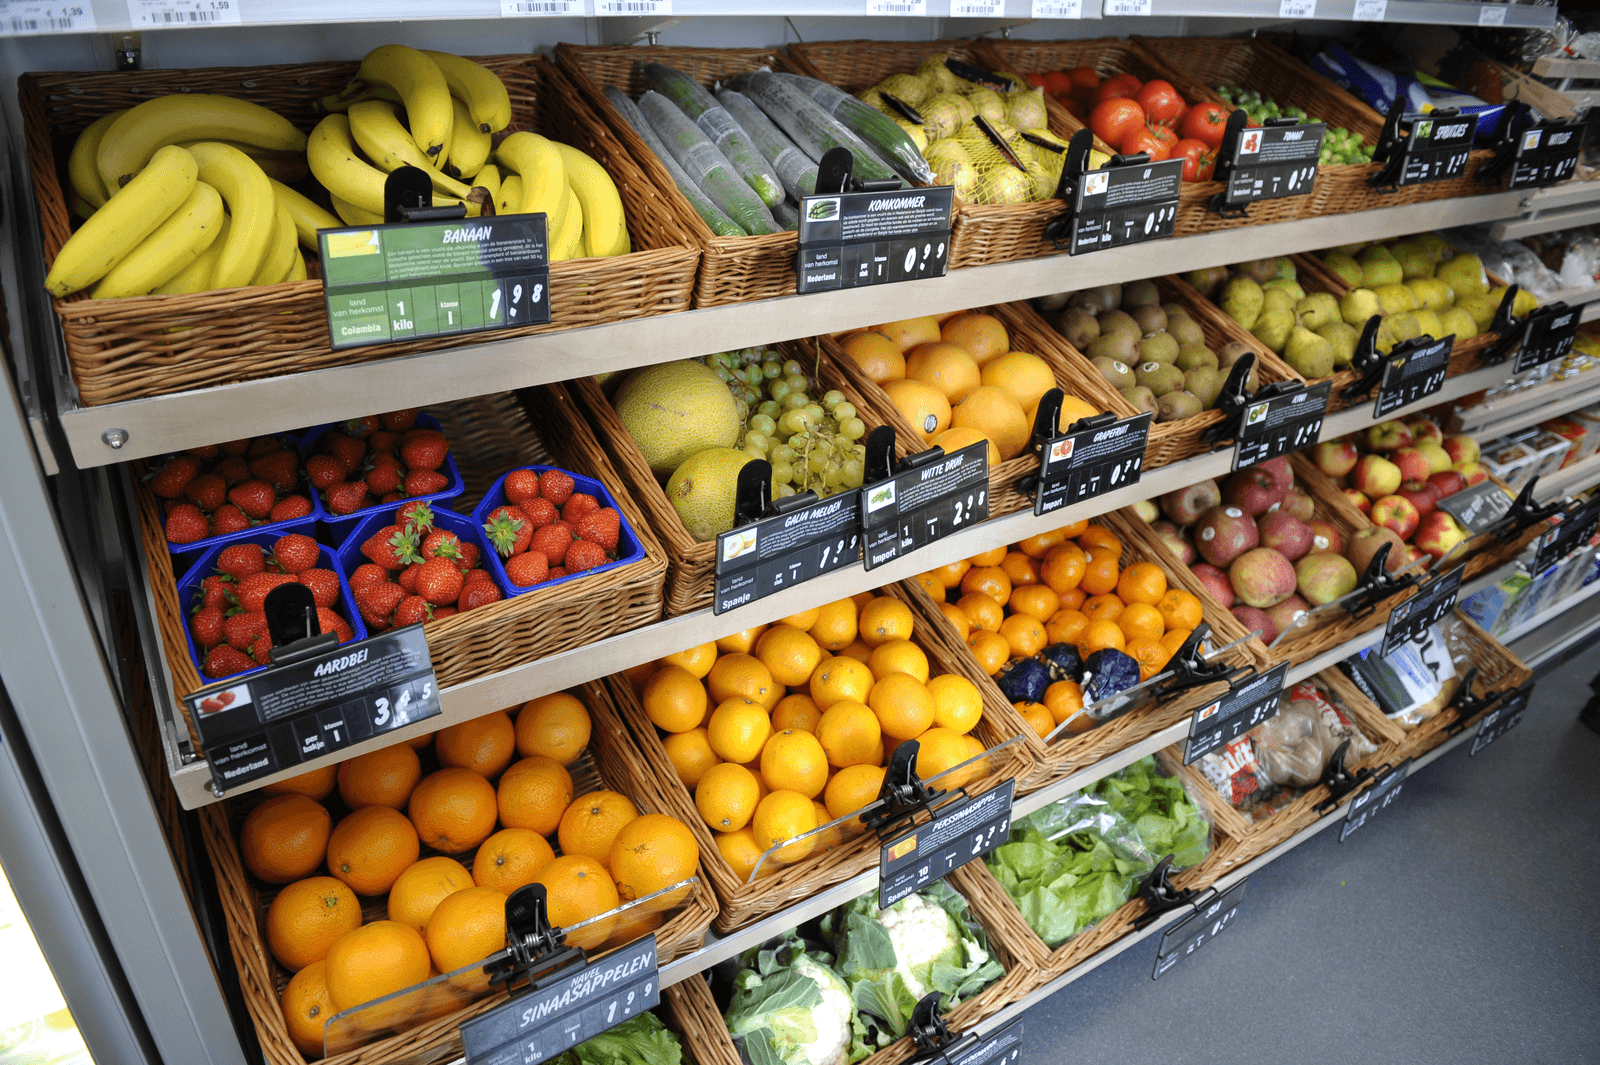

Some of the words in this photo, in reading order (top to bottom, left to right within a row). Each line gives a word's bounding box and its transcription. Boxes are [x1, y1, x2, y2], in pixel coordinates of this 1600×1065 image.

[210, 2, 229, 10] 1,59
[868, 196, 926, 212] KOMKOMMER
[443, 226, 492, 244] BANAAN
[815, 259, 838, 267] herkomst
[807, 273, 836, 283] Nederland
[350, 298, 366, 306] land
[333, 308, 347, 318] van
[348, 304, 384, 316] herkomst
[341, 324, 381, 335] Colombia
[394, 318, 413, 331] kilo
[1093, 424, 1130, 442] GRAPEFRUIT
[921, 464, 944, 480] WITTE
[945, 454, 964, 472] DRUIF
[1042, 498, 1062, 511] Import
[784, 511, 808, 528] GALIA
[810, 500, 842, 519] MELOEN
[869, 540, 877, 548] van
[878, 532, 897, 544] herkomst
[878, 530, 888, 538] land
[902, 537, 913, 548] kilo
[873, 547, 896, 564] Import
[731, 578, 754, 591] herkomst
[732, 576, 743, 584] land
[723, 593, 750, 609] Spanje
[314, 648, 368, 677] AARDBEI
[324, 720, 344, 731] klasse
[303, 740, 325, 754] bakje
[305, 734, 318, 746] per
[214, 755, 229, 765] van
[230, 742, 267, 761] herkomst
[229, 741, 248, 754] land
[224, 757, 269, 780] Nederland
[932, 792, 996, 832] PERSSINAASAPPEL
[919, 866, 928, 876] 10
[888, 886, 912, 904] Spanje
[570, 967, 600, 988] NAVEL
[520, 952, 652, 1028] SINAASAPPELEN
[525, 1051, 542, 1064] kilo
